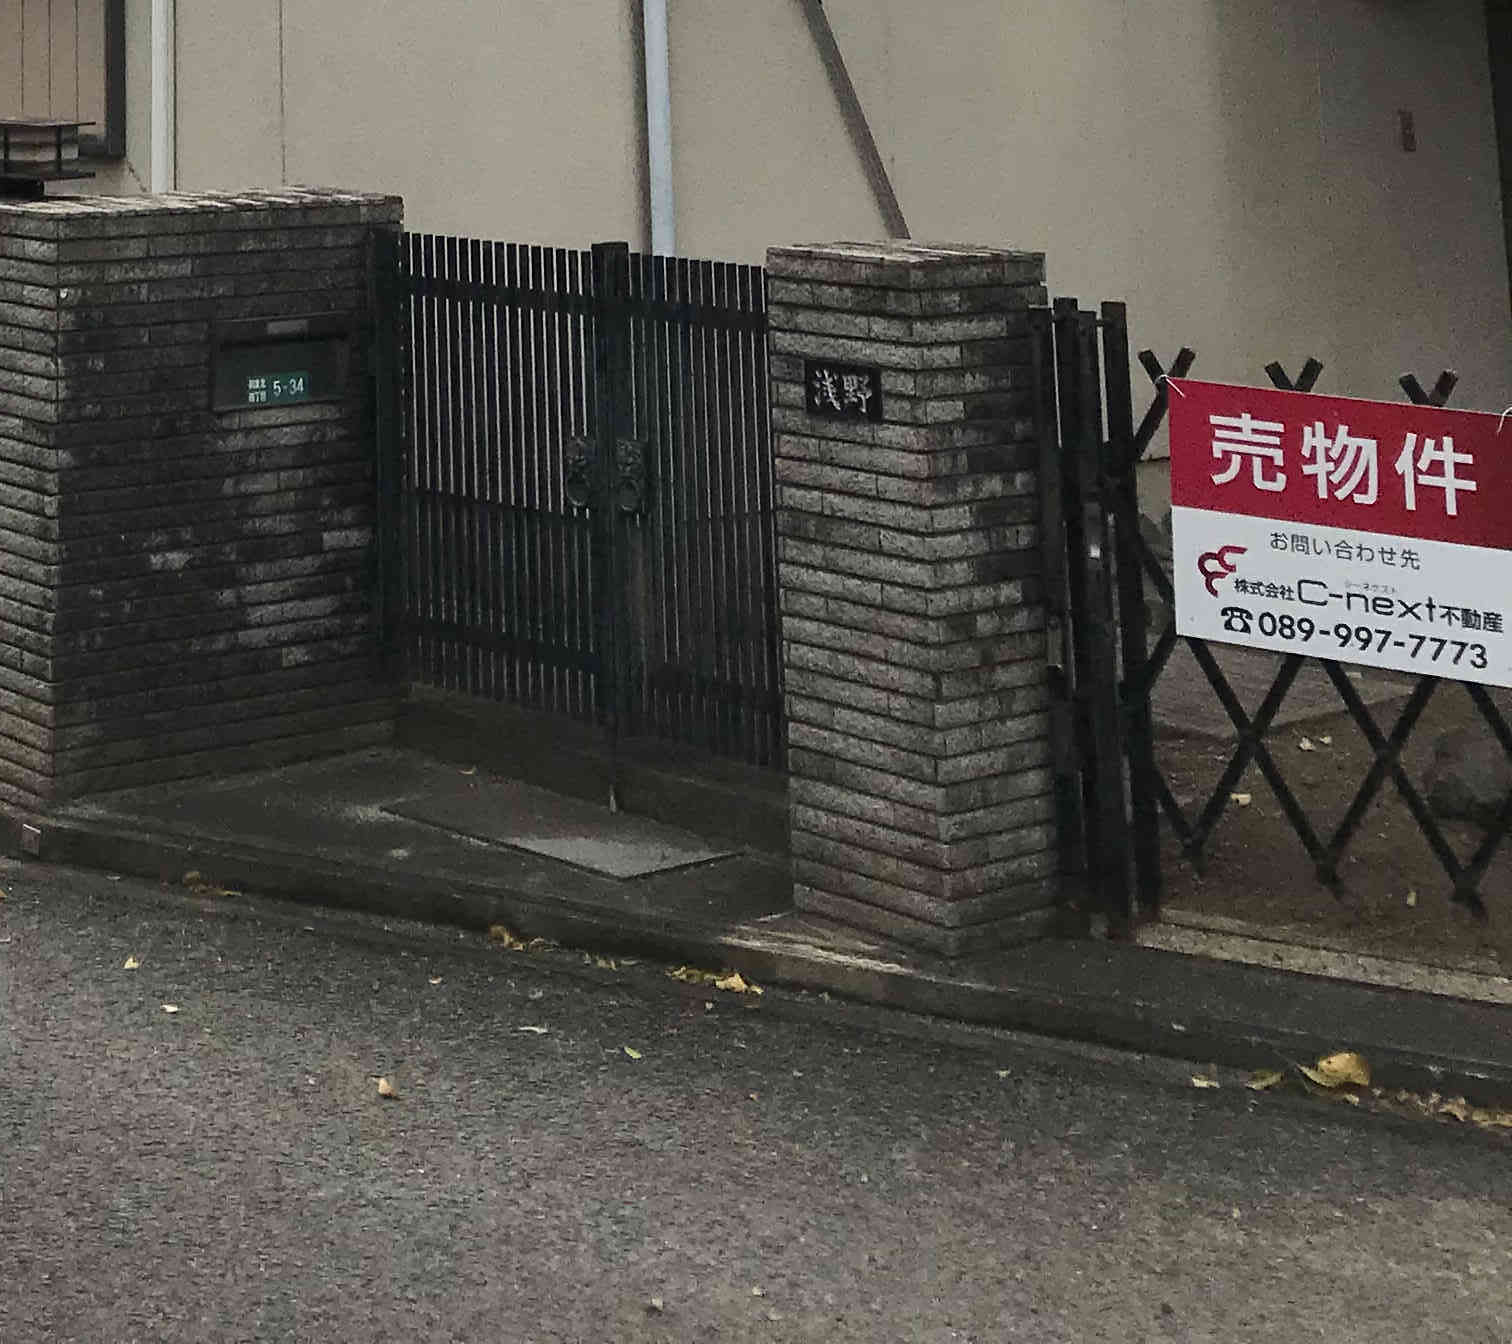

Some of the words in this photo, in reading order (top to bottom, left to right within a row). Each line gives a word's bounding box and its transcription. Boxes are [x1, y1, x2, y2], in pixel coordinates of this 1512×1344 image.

[273, 377, 304, 397] 5-34
[1209, 412, 1478, 516] 売物件
[1269, 531, 1421, 571] お問い合わせ先
[1258, 611, 1489, 669] 089-997-7773
